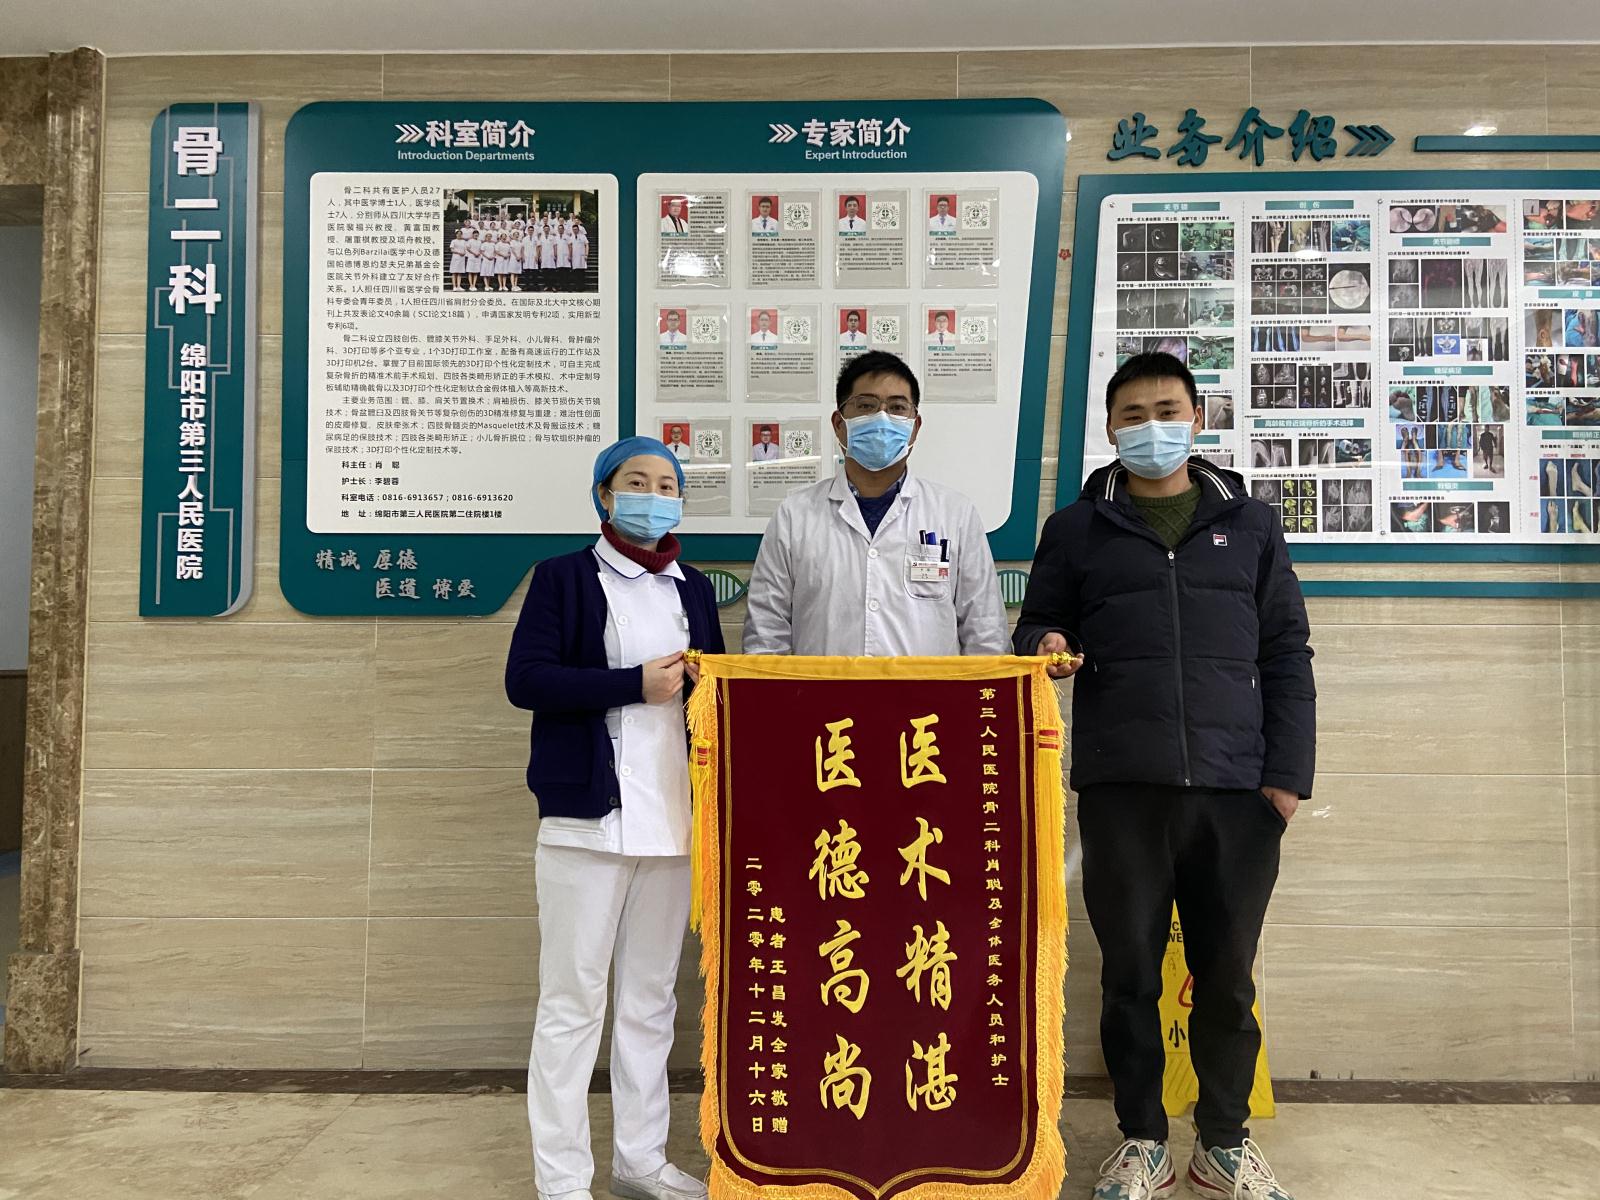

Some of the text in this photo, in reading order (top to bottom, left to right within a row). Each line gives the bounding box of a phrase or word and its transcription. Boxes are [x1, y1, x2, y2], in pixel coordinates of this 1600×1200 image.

[425, 120, 536, 148] 科室简介
[801, 118, 911, 147] 专家简介
[1107, 107, 1337, 167] 业务介绍
[397, 150, 535, 161] Introduction Departments
[805, 149, 907, 161] Expert Introduction
[170, 126, 223, 315] 骨二科
[176, 343, 207, 580] 绵阳市第三人民医院
[373, 548, 418, 570] 厚德
[375, 577, 421, 599] 医道
[808, 717, 872, 1120] 医德高尚
[895, 713, 958, 1112] 医术精湛
[745, 857, 766, 1133] 二零二零年十二月十六日
